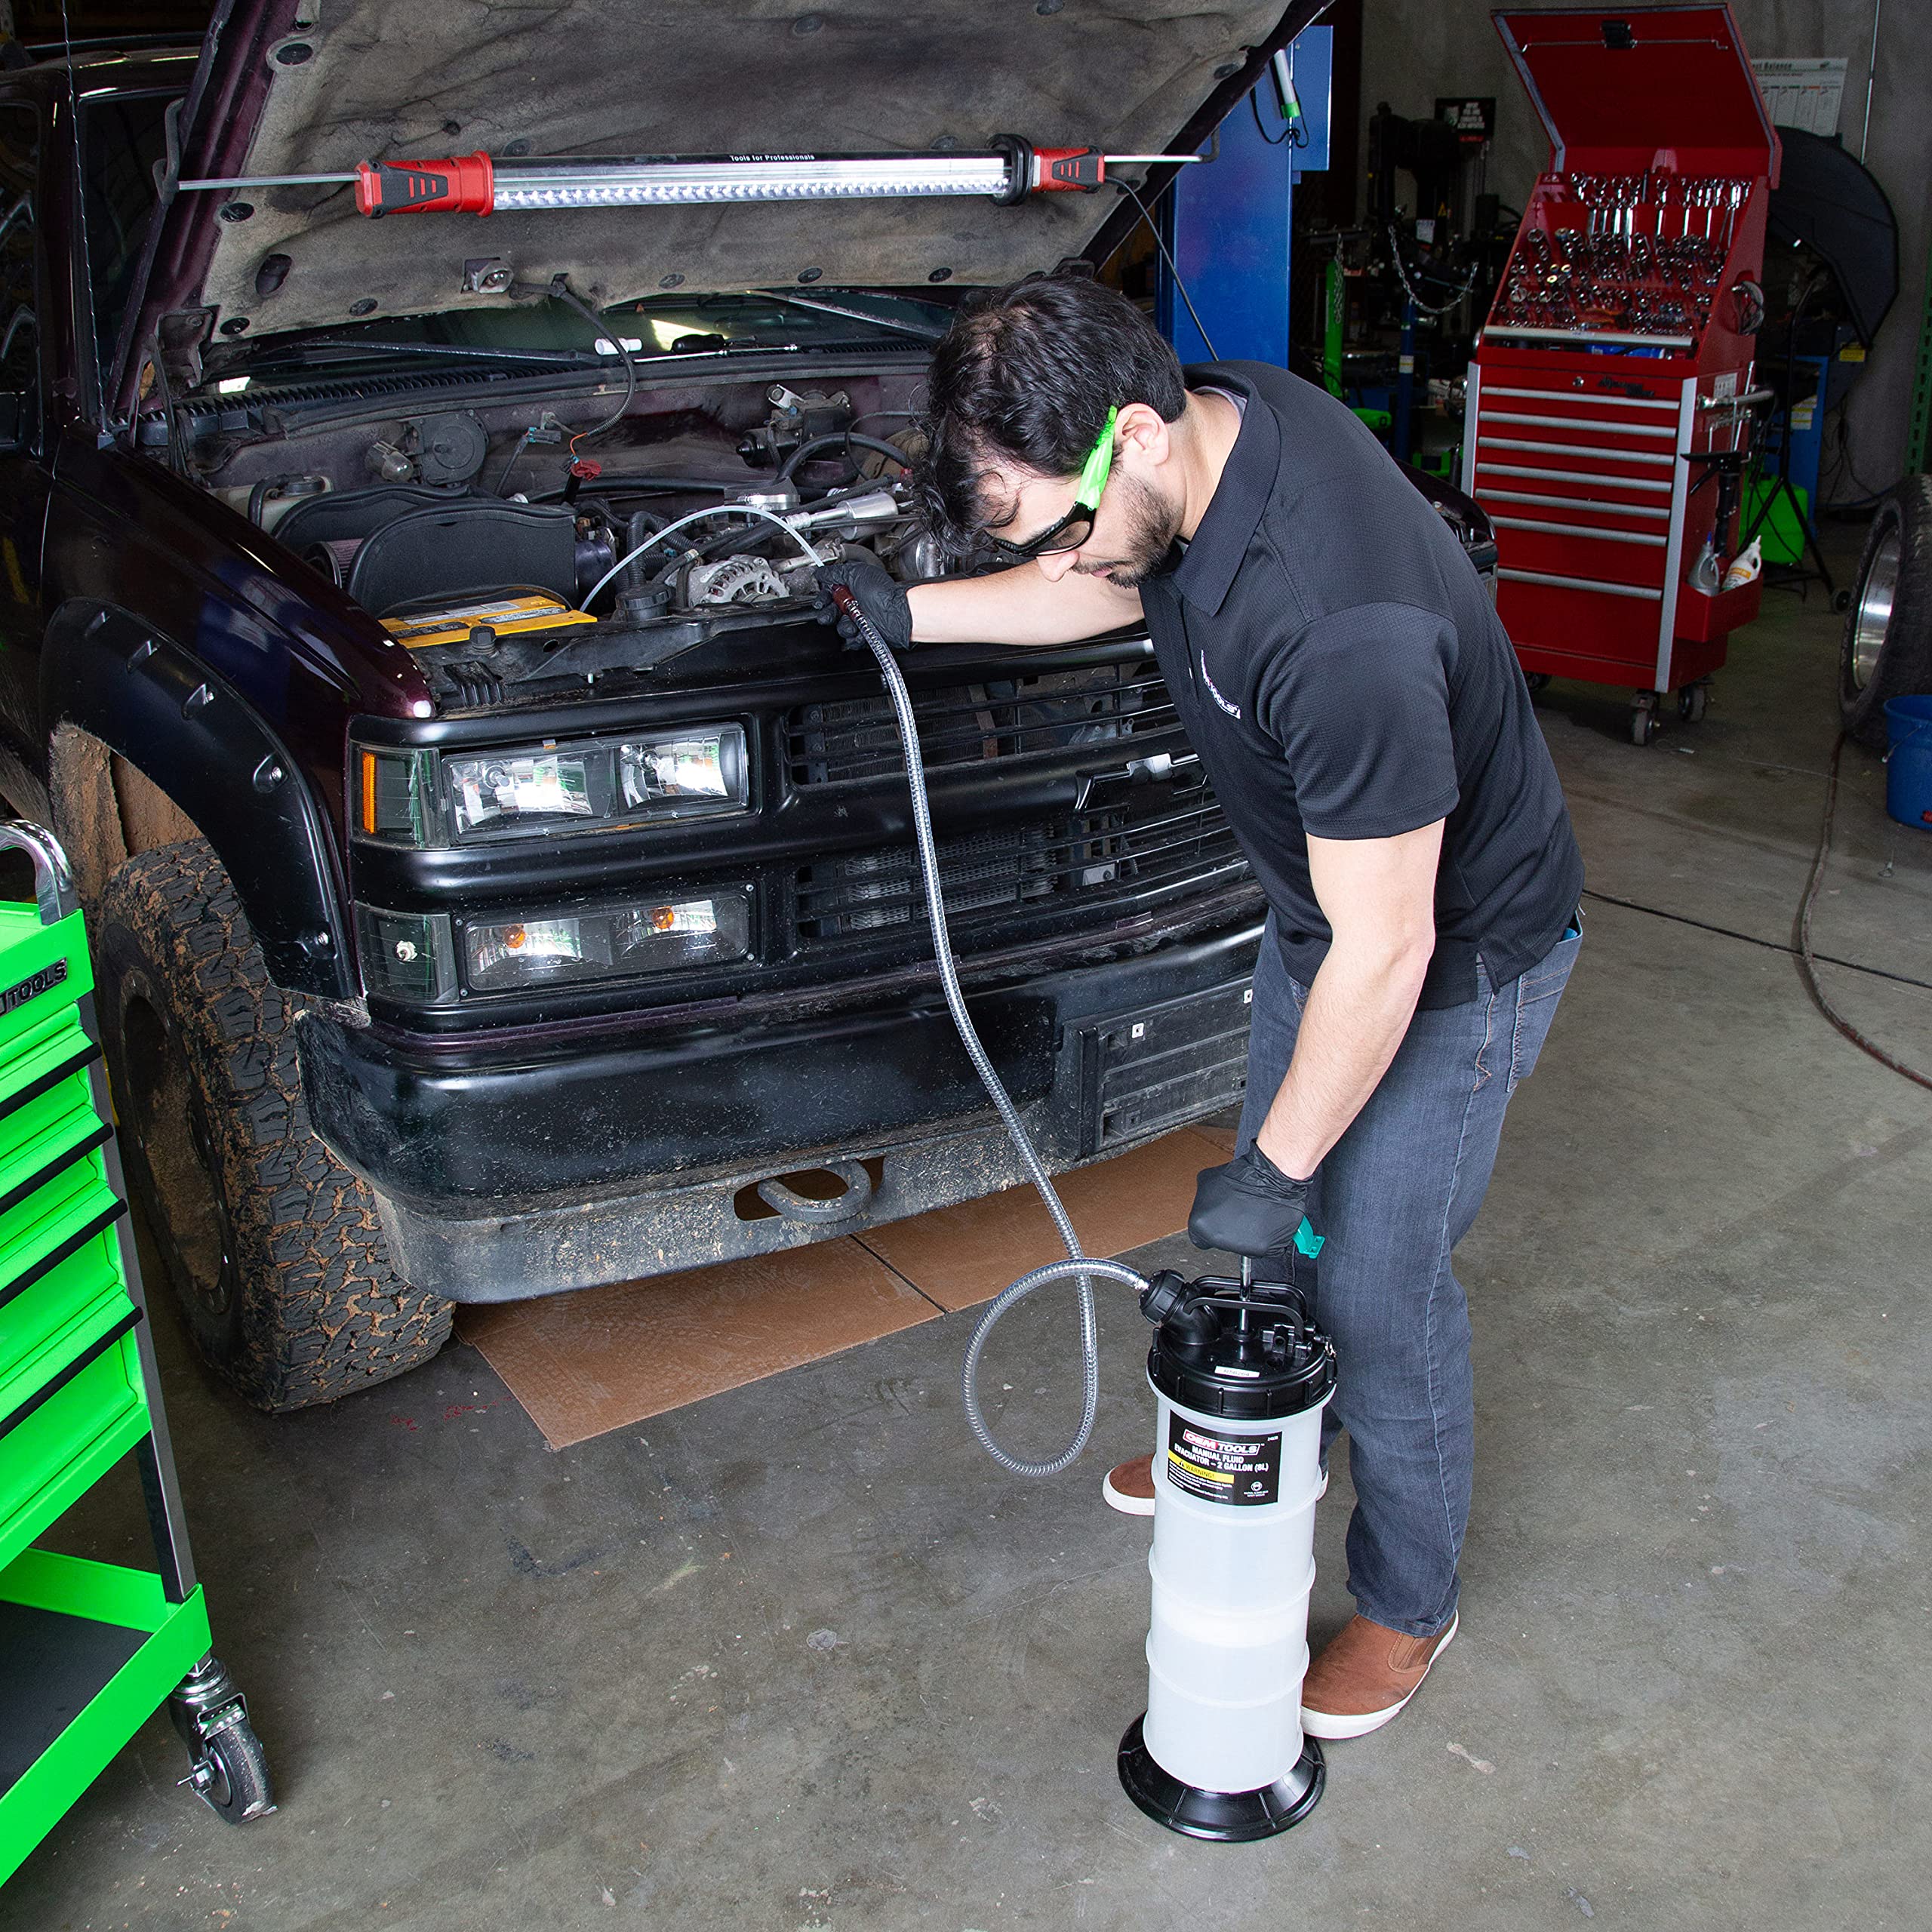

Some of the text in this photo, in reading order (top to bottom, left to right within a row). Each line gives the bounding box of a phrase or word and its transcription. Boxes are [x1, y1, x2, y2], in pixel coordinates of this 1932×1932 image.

[1192, 1445, 1244, 1464] MANUAL FLUID
[1217, 1443, 1258, 1454] TOOLS
[1174, 1443, 1210, 1466] EVACUATOR
[1217, 1461, 1223, 1470] 2
[1223, 1463, 1254, 1472] GALLON
[1254, 1463, 1269, 1473] (8L)
[1186, 1463, 1214, 1479] WARNING!
